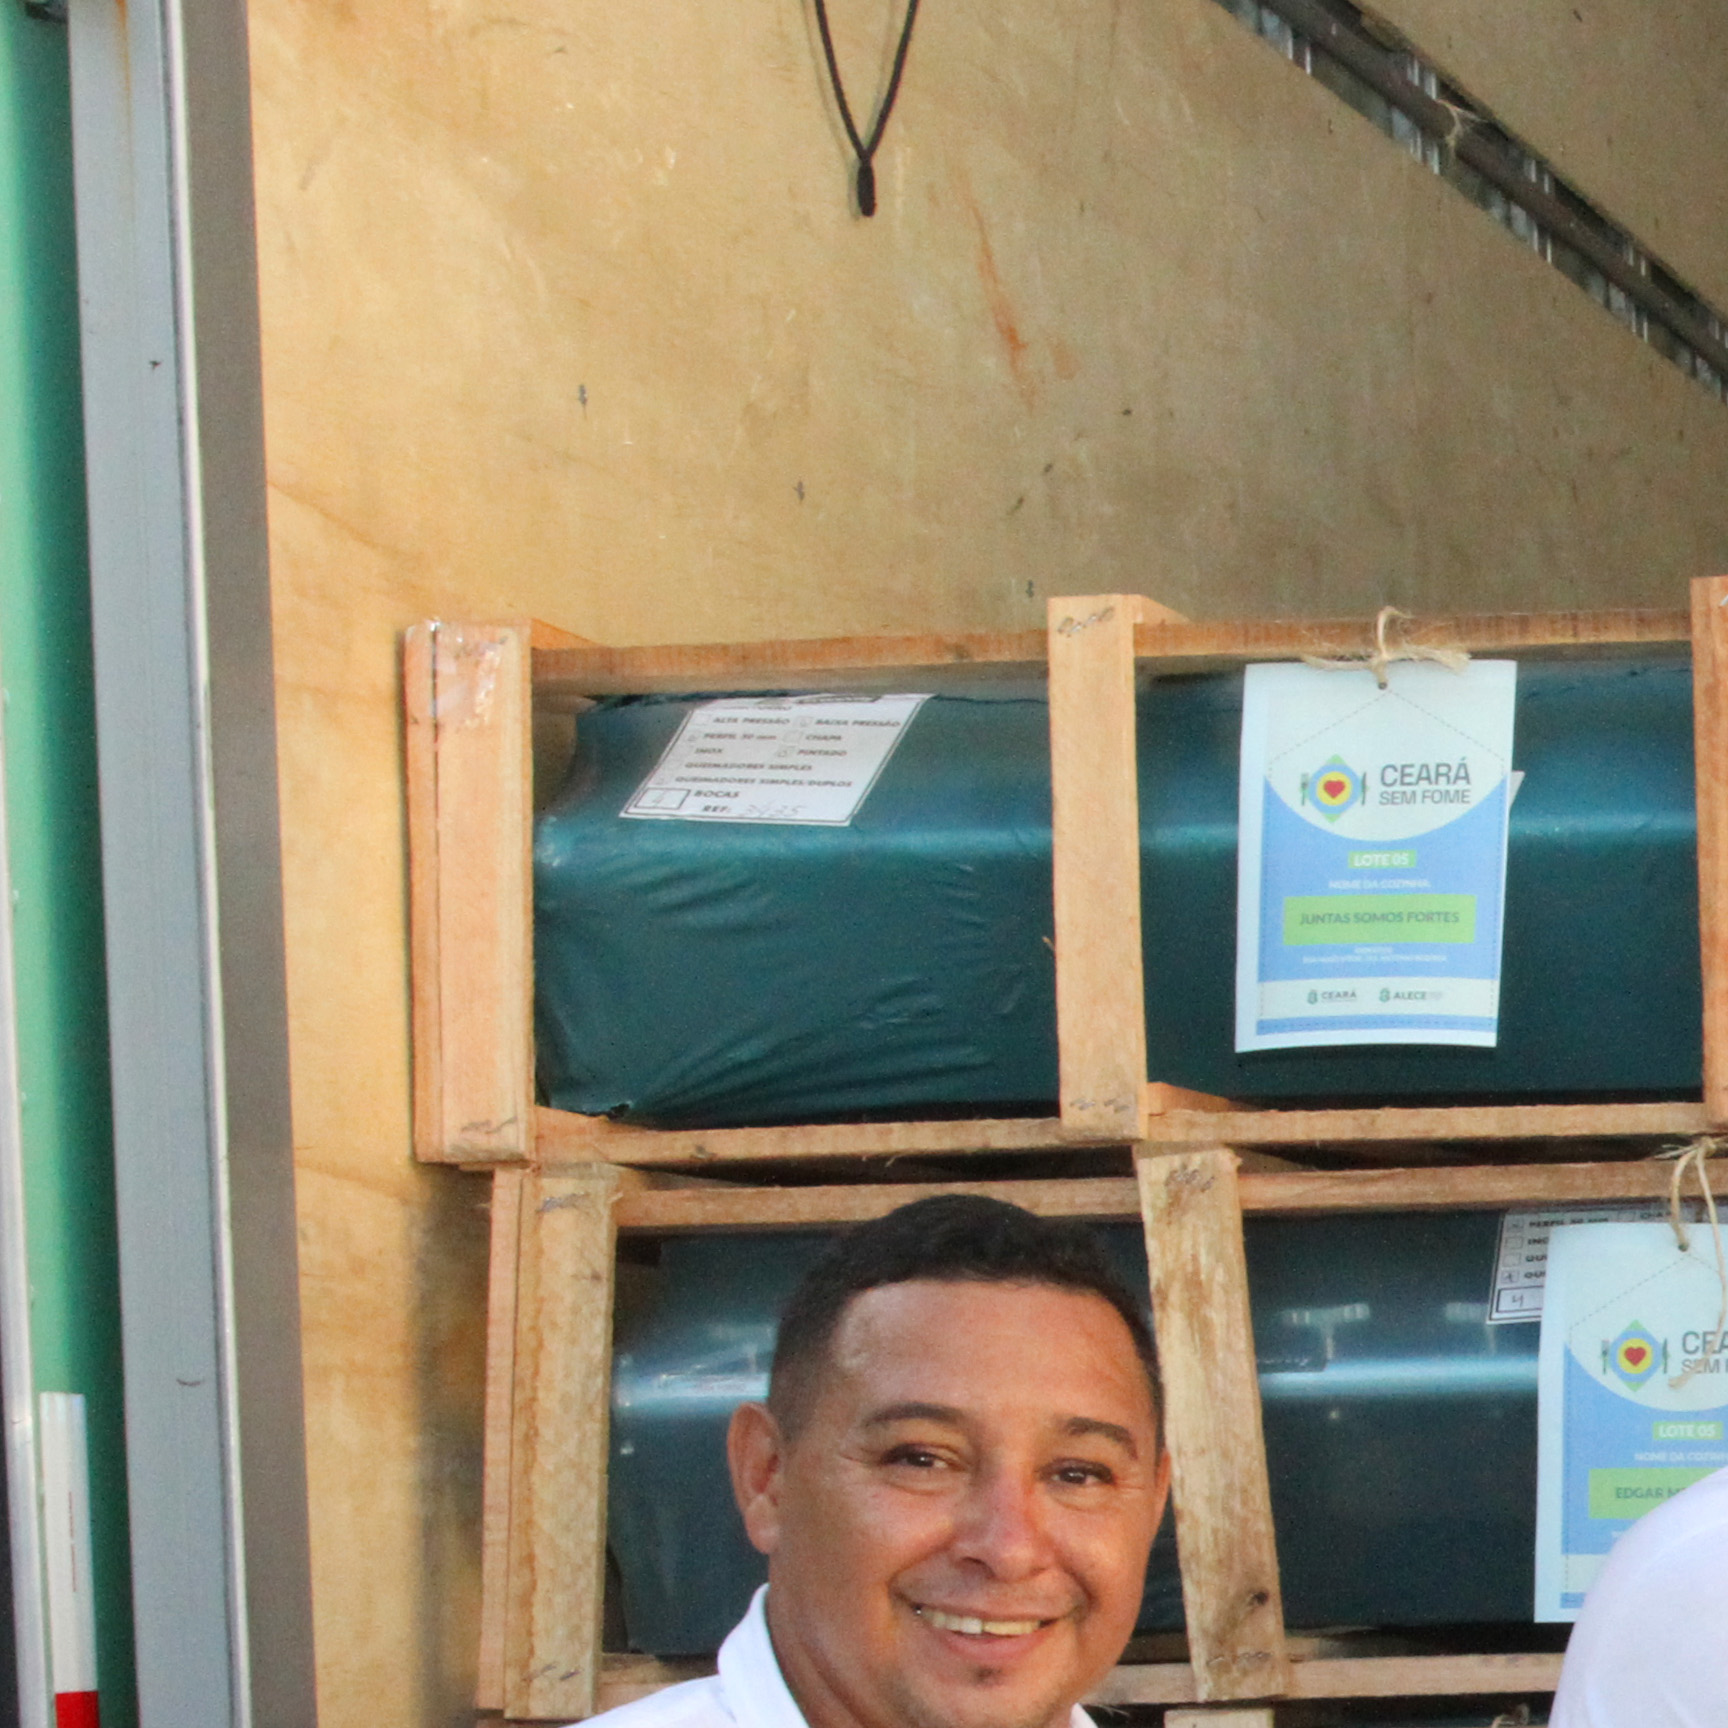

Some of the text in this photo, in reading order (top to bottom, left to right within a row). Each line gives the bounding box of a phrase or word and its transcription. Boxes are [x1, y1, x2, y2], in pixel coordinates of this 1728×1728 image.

[742, 716, 790, 725] PRESSÃO
[797, 749, 847, 757] PINTADO
[1380, 756, 1471, 788] CEARÁ
[694, 789, 740, 799] BOCAS
[1378, 788, 1471, 806] SEM FOME
[1353, 852, 1410, 867] LOTE 05
[1300, 911, 1460, 926] JUNTAS SOMOS FORTES
[1321, 988, 1357, 999] CEARÁ
[1658, 1424, 1717, 1438] LOTE 05
[1616, 1487, 1664, 1499] EDGAR
